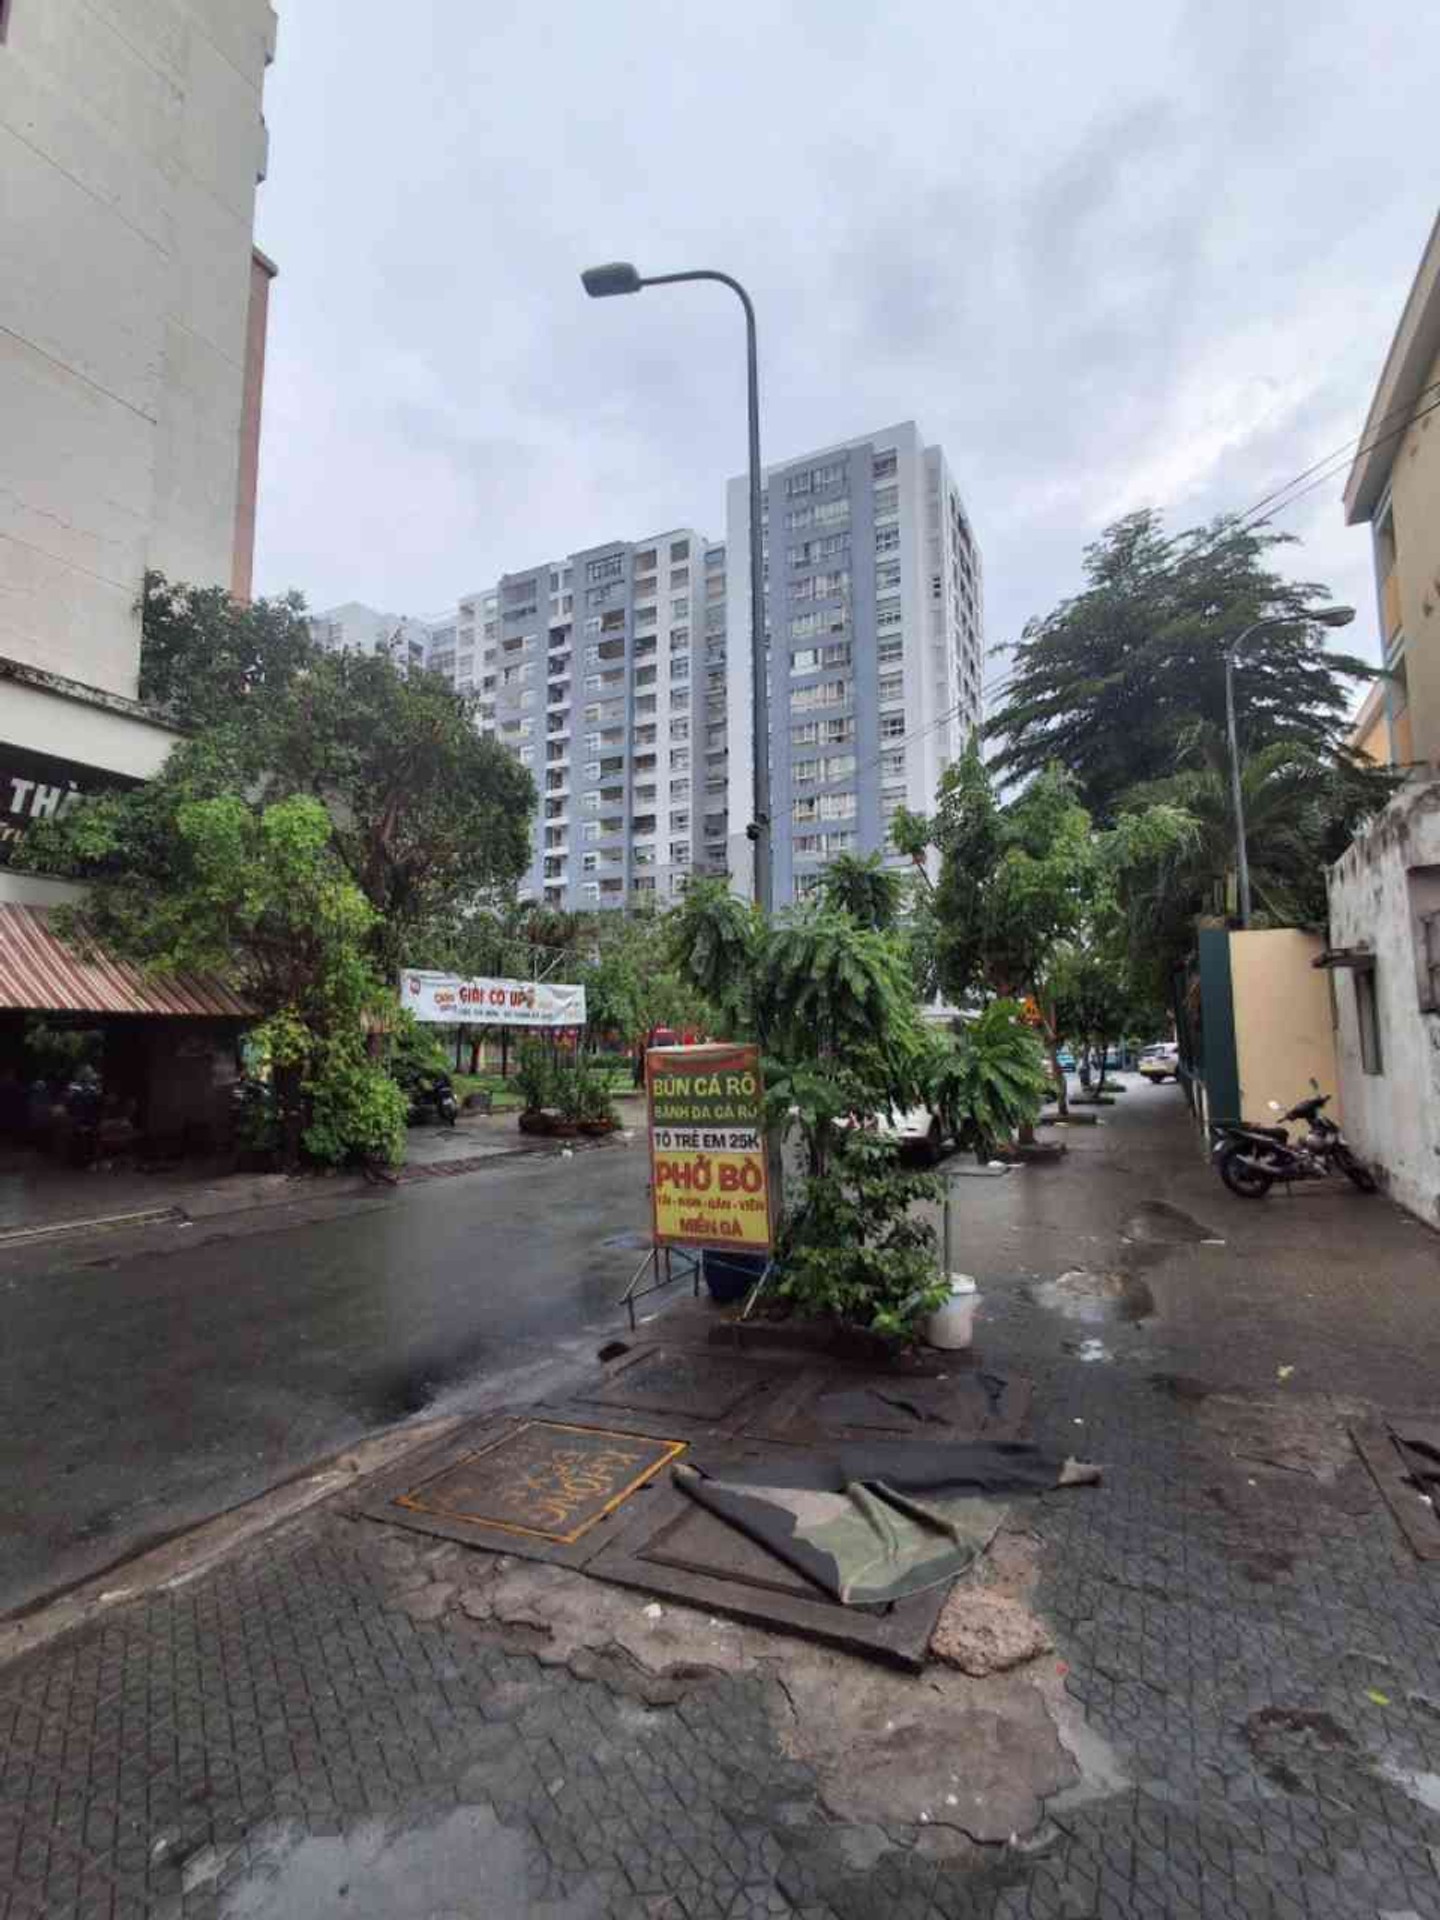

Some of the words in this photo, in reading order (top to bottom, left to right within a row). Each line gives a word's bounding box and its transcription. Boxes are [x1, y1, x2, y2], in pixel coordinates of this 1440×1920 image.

[694, 1073, 721, 1097] CÁ
[726, 1072, 756, 1096] RÔ
[703, 1132, 727, 1149] EM
[729, 1132, 760, 1150] 25K
[655, 1153, 712, 1192] PHỞ
[718, 1156, 763, 1193] BÒ
